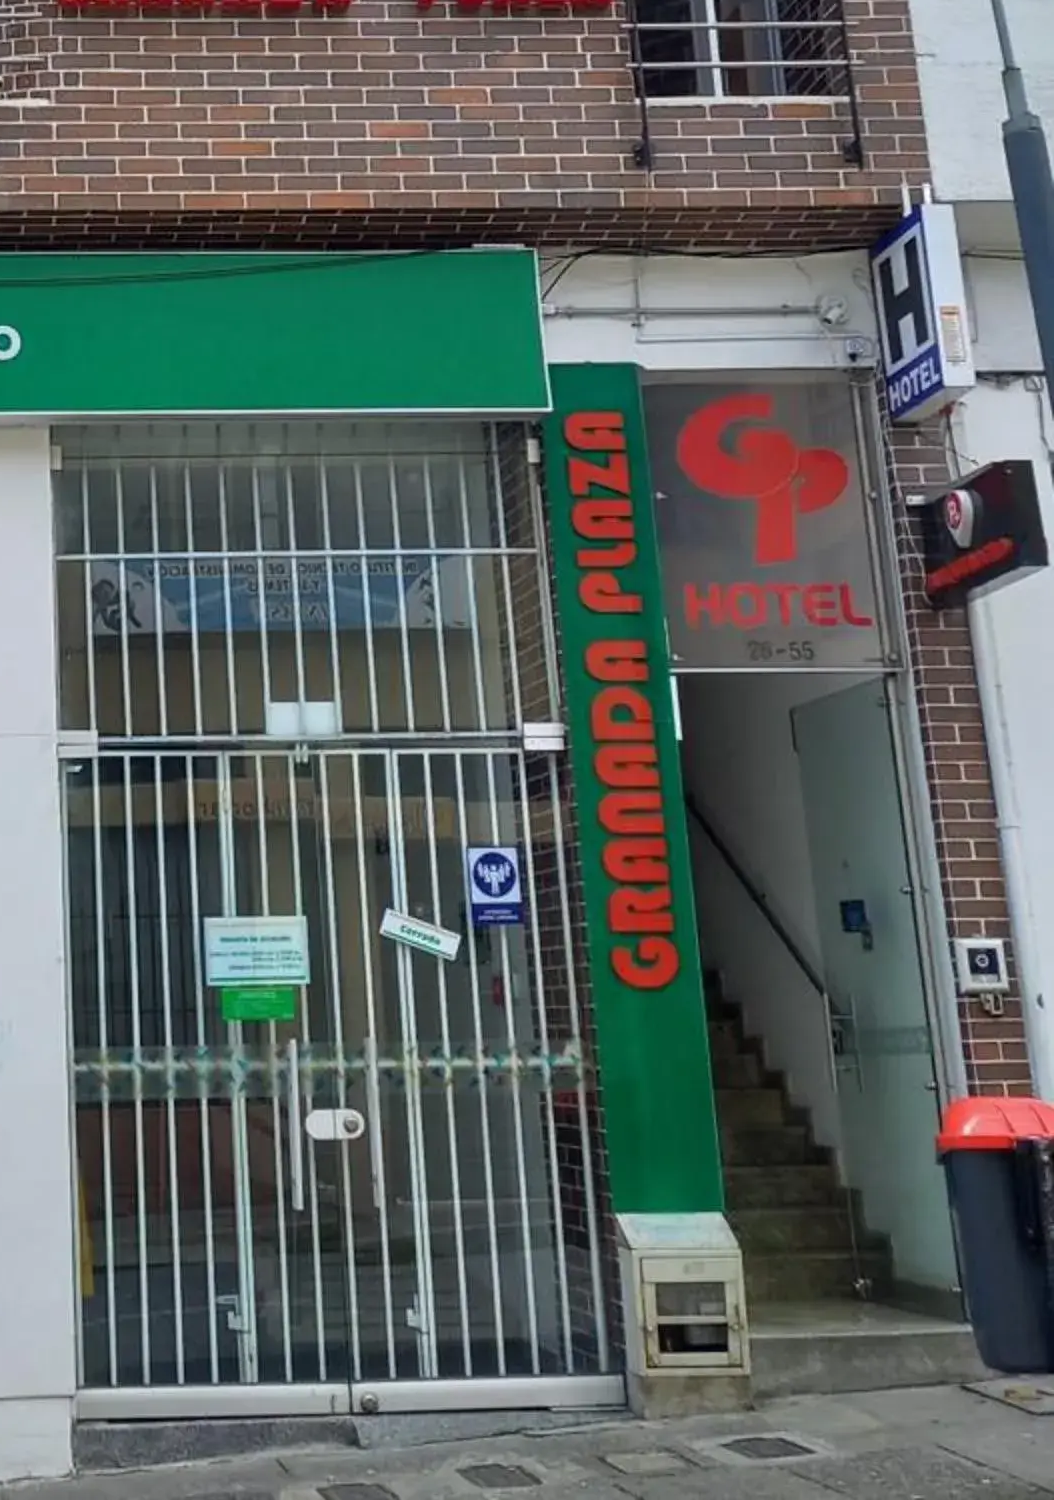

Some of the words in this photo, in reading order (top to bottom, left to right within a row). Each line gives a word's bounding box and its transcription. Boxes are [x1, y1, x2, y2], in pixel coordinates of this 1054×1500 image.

[878, 235, 929, 365] H
[887, 357, 941, 412] HOTEL
[563, 411, 643, 614] PLAZA
[683, 582, 873, 630] HOTEL
[584, 639, 680, 990] GRANADA
